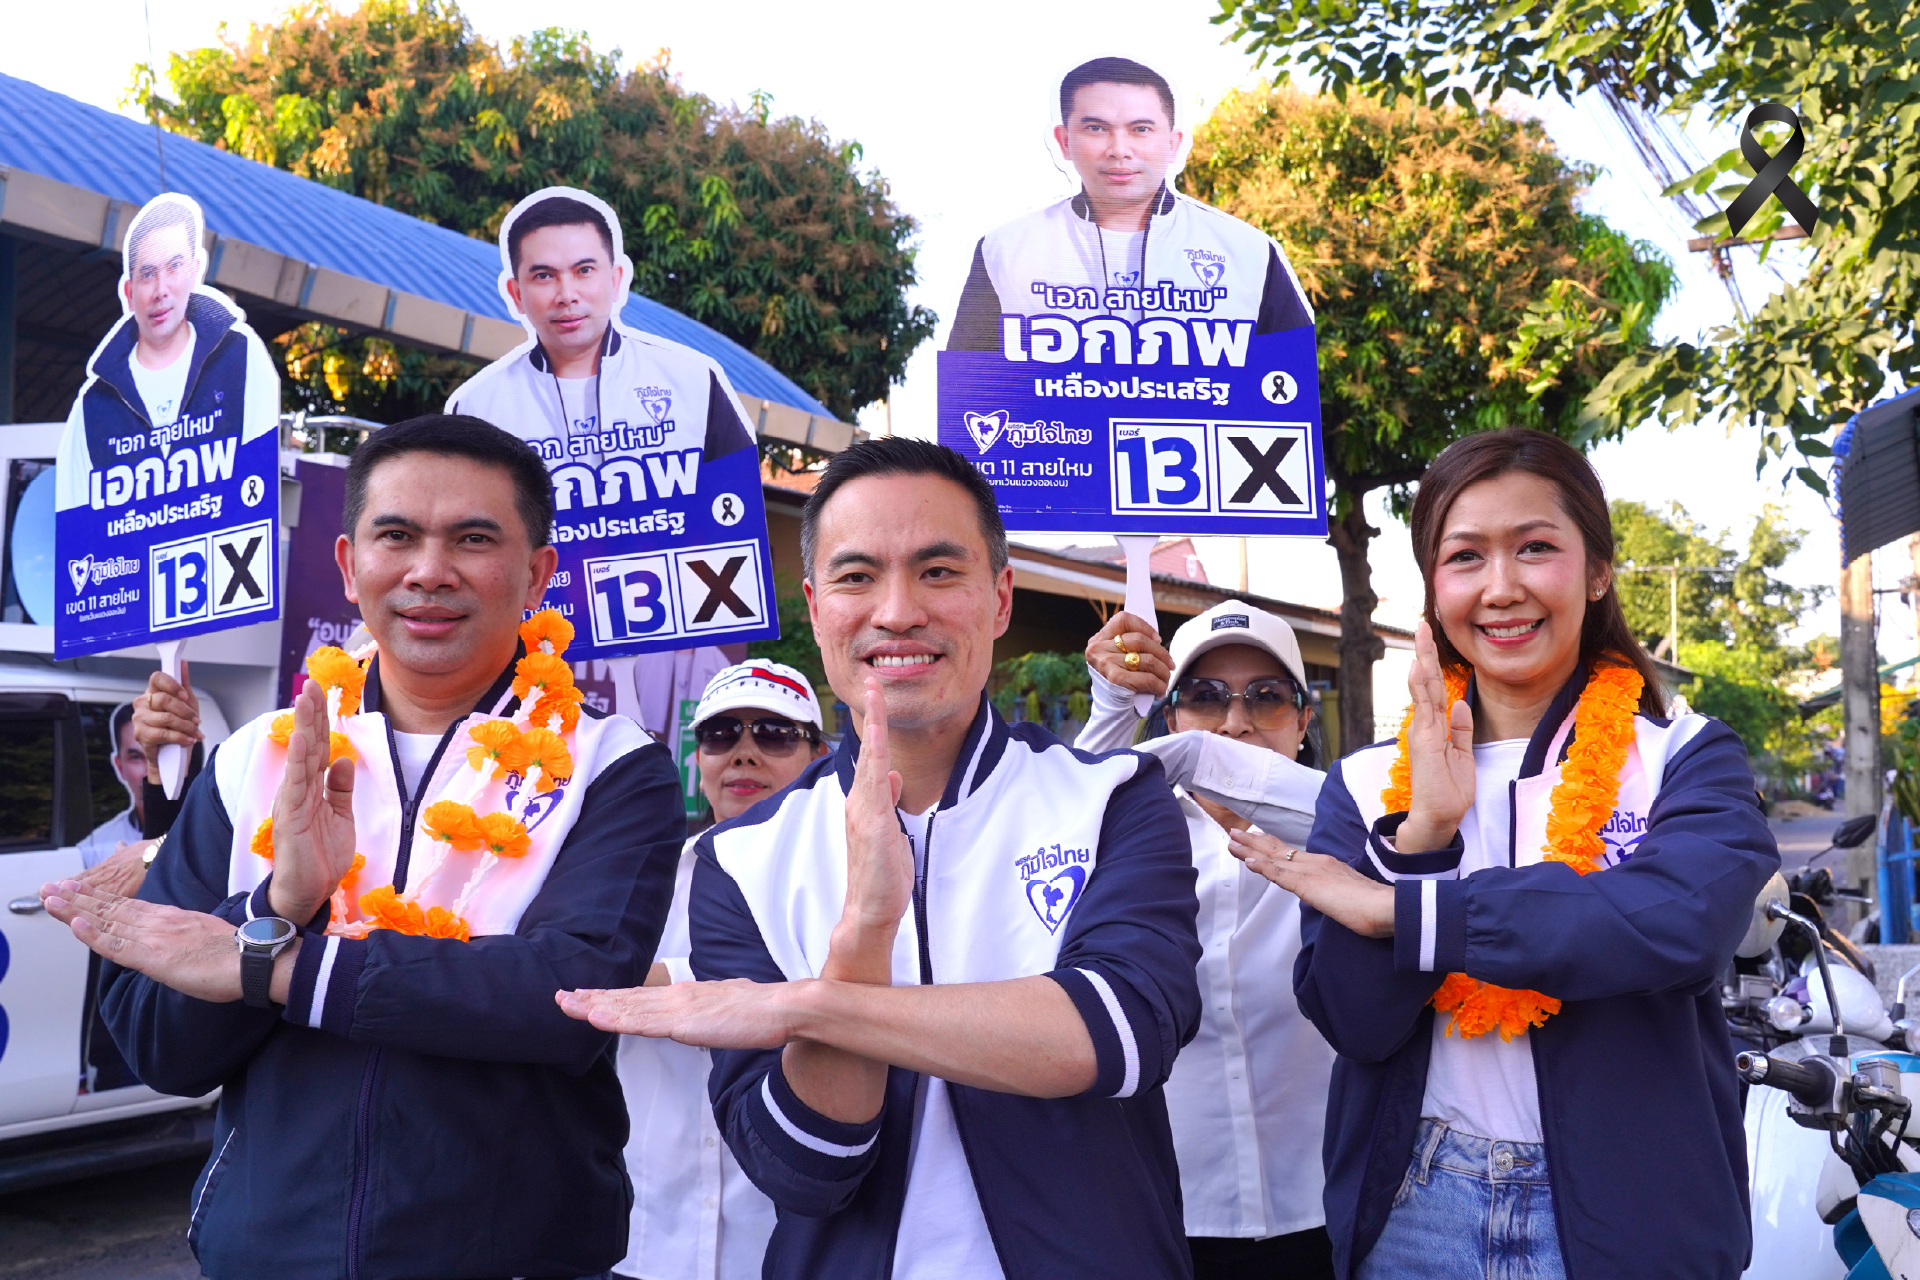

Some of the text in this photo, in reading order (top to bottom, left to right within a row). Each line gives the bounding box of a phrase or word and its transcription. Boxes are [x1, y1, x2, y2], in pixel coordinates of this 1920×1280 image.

[1032, 282, 1227, 312] "เอก สายไหม"
[1002, 316, 1252, 368] เอกภพ
[1034, 372, 1231, 405] เหลืองประเสริฐ
[149, 411, 223, 445] สายไหม"
[568, 421, 675, 456] สายไหม"
[1008, 421, 1092, 448] ภูมิใจไทย
[90, 436, 238, 511] เอกภพ
[1001, 460, 1016, 476] 11
[1021, 458, 1093, 477] สายไหม
[1116, 436, 1202, 504] 13
[107, 494, 223, 537] เหลืองประเสริฐ
[66, 587, 140, 615] เขต 11 สายไหม
[158, 551, 207, 620] 13
[594, 570, 667, 640] 13
[1020, 843, 1090, 881] ภูมิใจไทย
